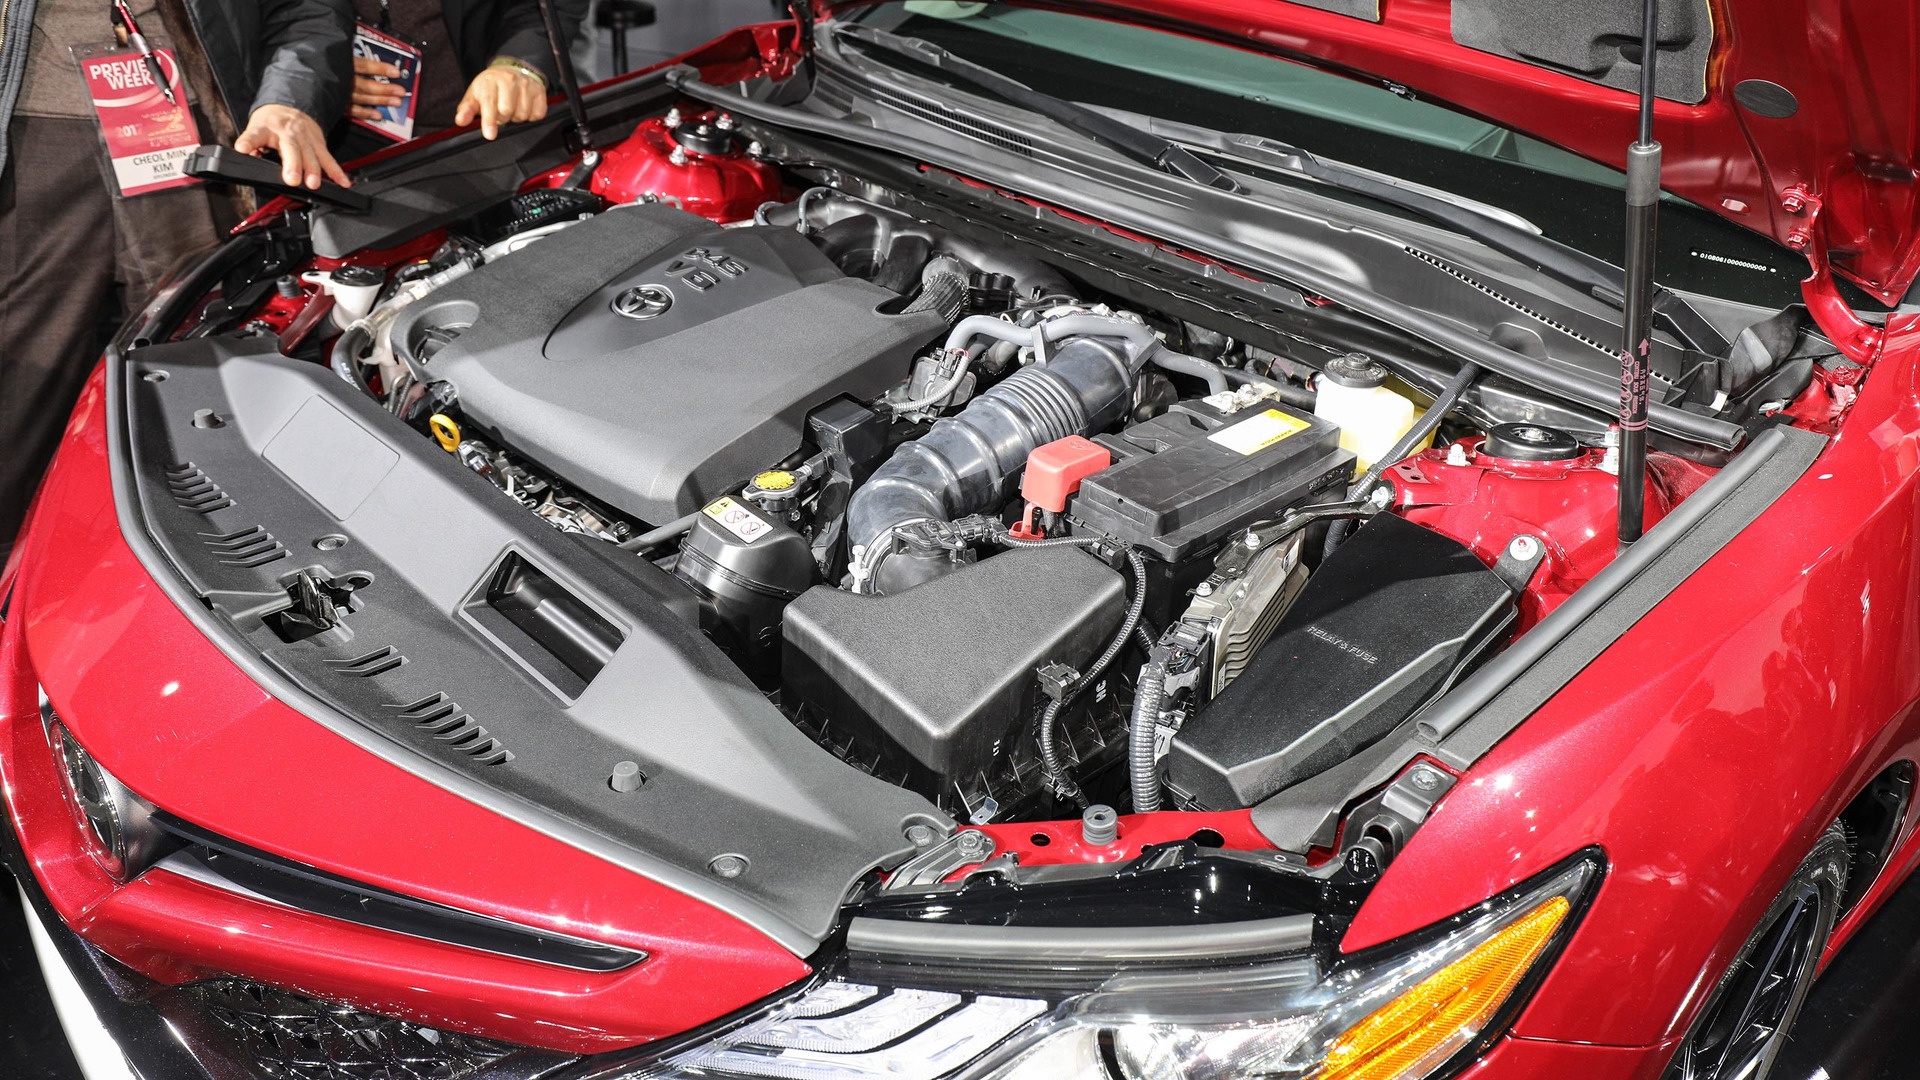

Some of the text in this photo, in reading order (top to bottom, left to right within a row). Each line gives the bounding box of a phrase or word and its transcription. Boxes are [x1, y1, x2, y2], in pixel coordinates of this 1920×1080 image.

[89, 56, 162, 80] PREVIE
[106, 70, 155, 90] WEEK
[133, 149, 187, 166] CHEOL MIN
[152, 162, 175, 174] KIM
[664, 260, 721, 292] V6
[1348, 645, 1379, 665] FUSE
